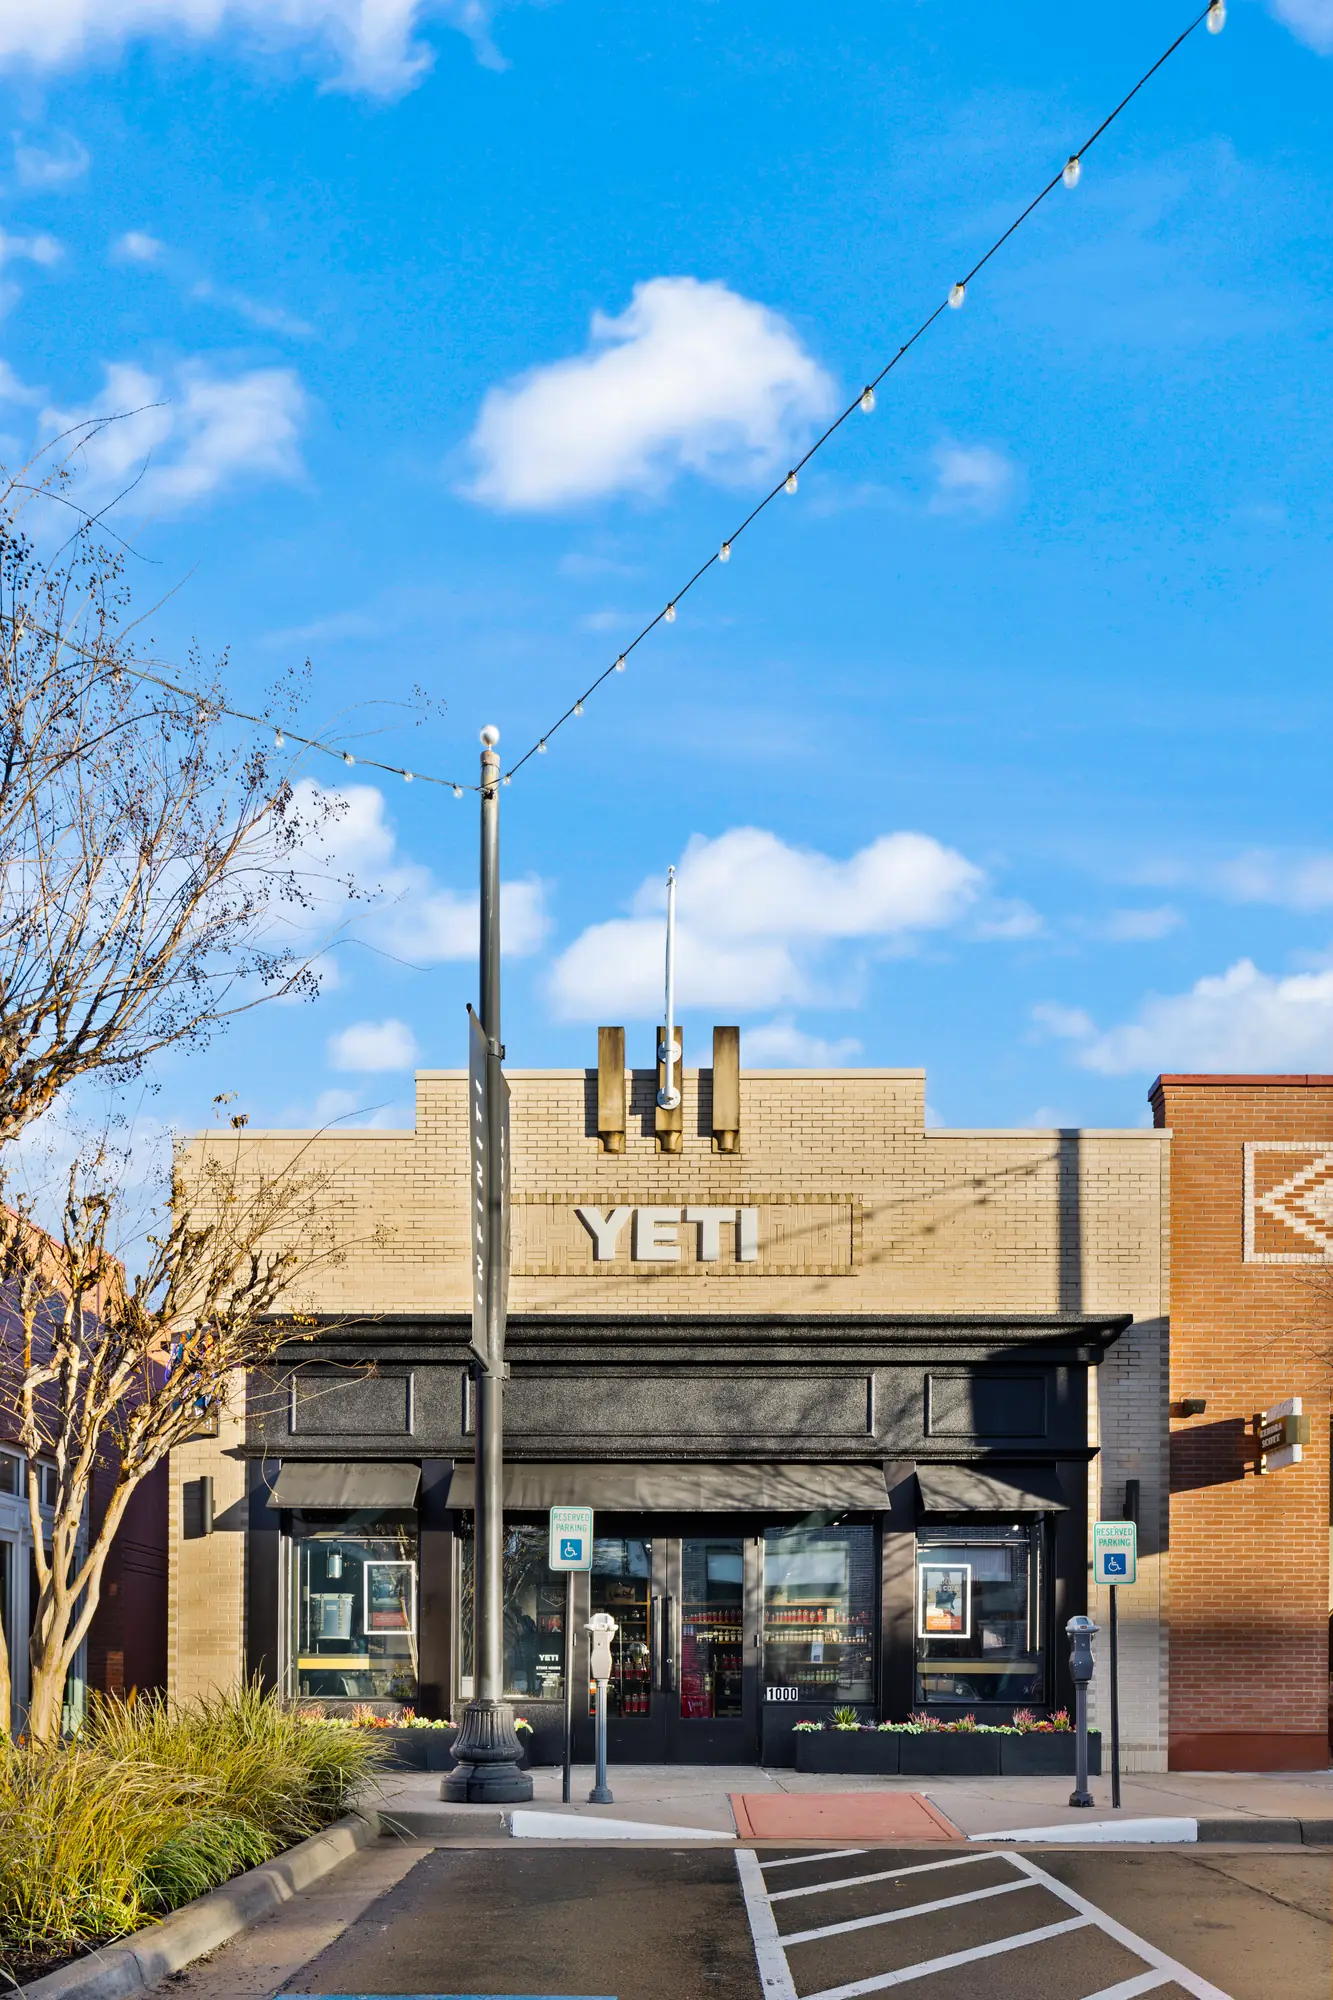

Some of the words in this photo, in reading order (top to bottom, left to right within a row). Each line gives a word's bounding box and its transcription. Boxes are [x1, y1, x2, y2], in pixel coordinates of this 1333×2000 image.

[475, 1078, 483, 1306] INFINITI
[574, 1206, 758, 1262] YETI
[1262, 1433, 1280, 1448] SCOTT
[553, 1513, 589, 1522] RESERVED
[556, 1523, 587, 1533] PARKING
[1096, 1527, 1133, 1537] RESERVED
[1099, 1538, 1131, 1547] PARKING
[539, 1654, 559, 1662] YETI
[769, 1688, 797, 1700] 1000
